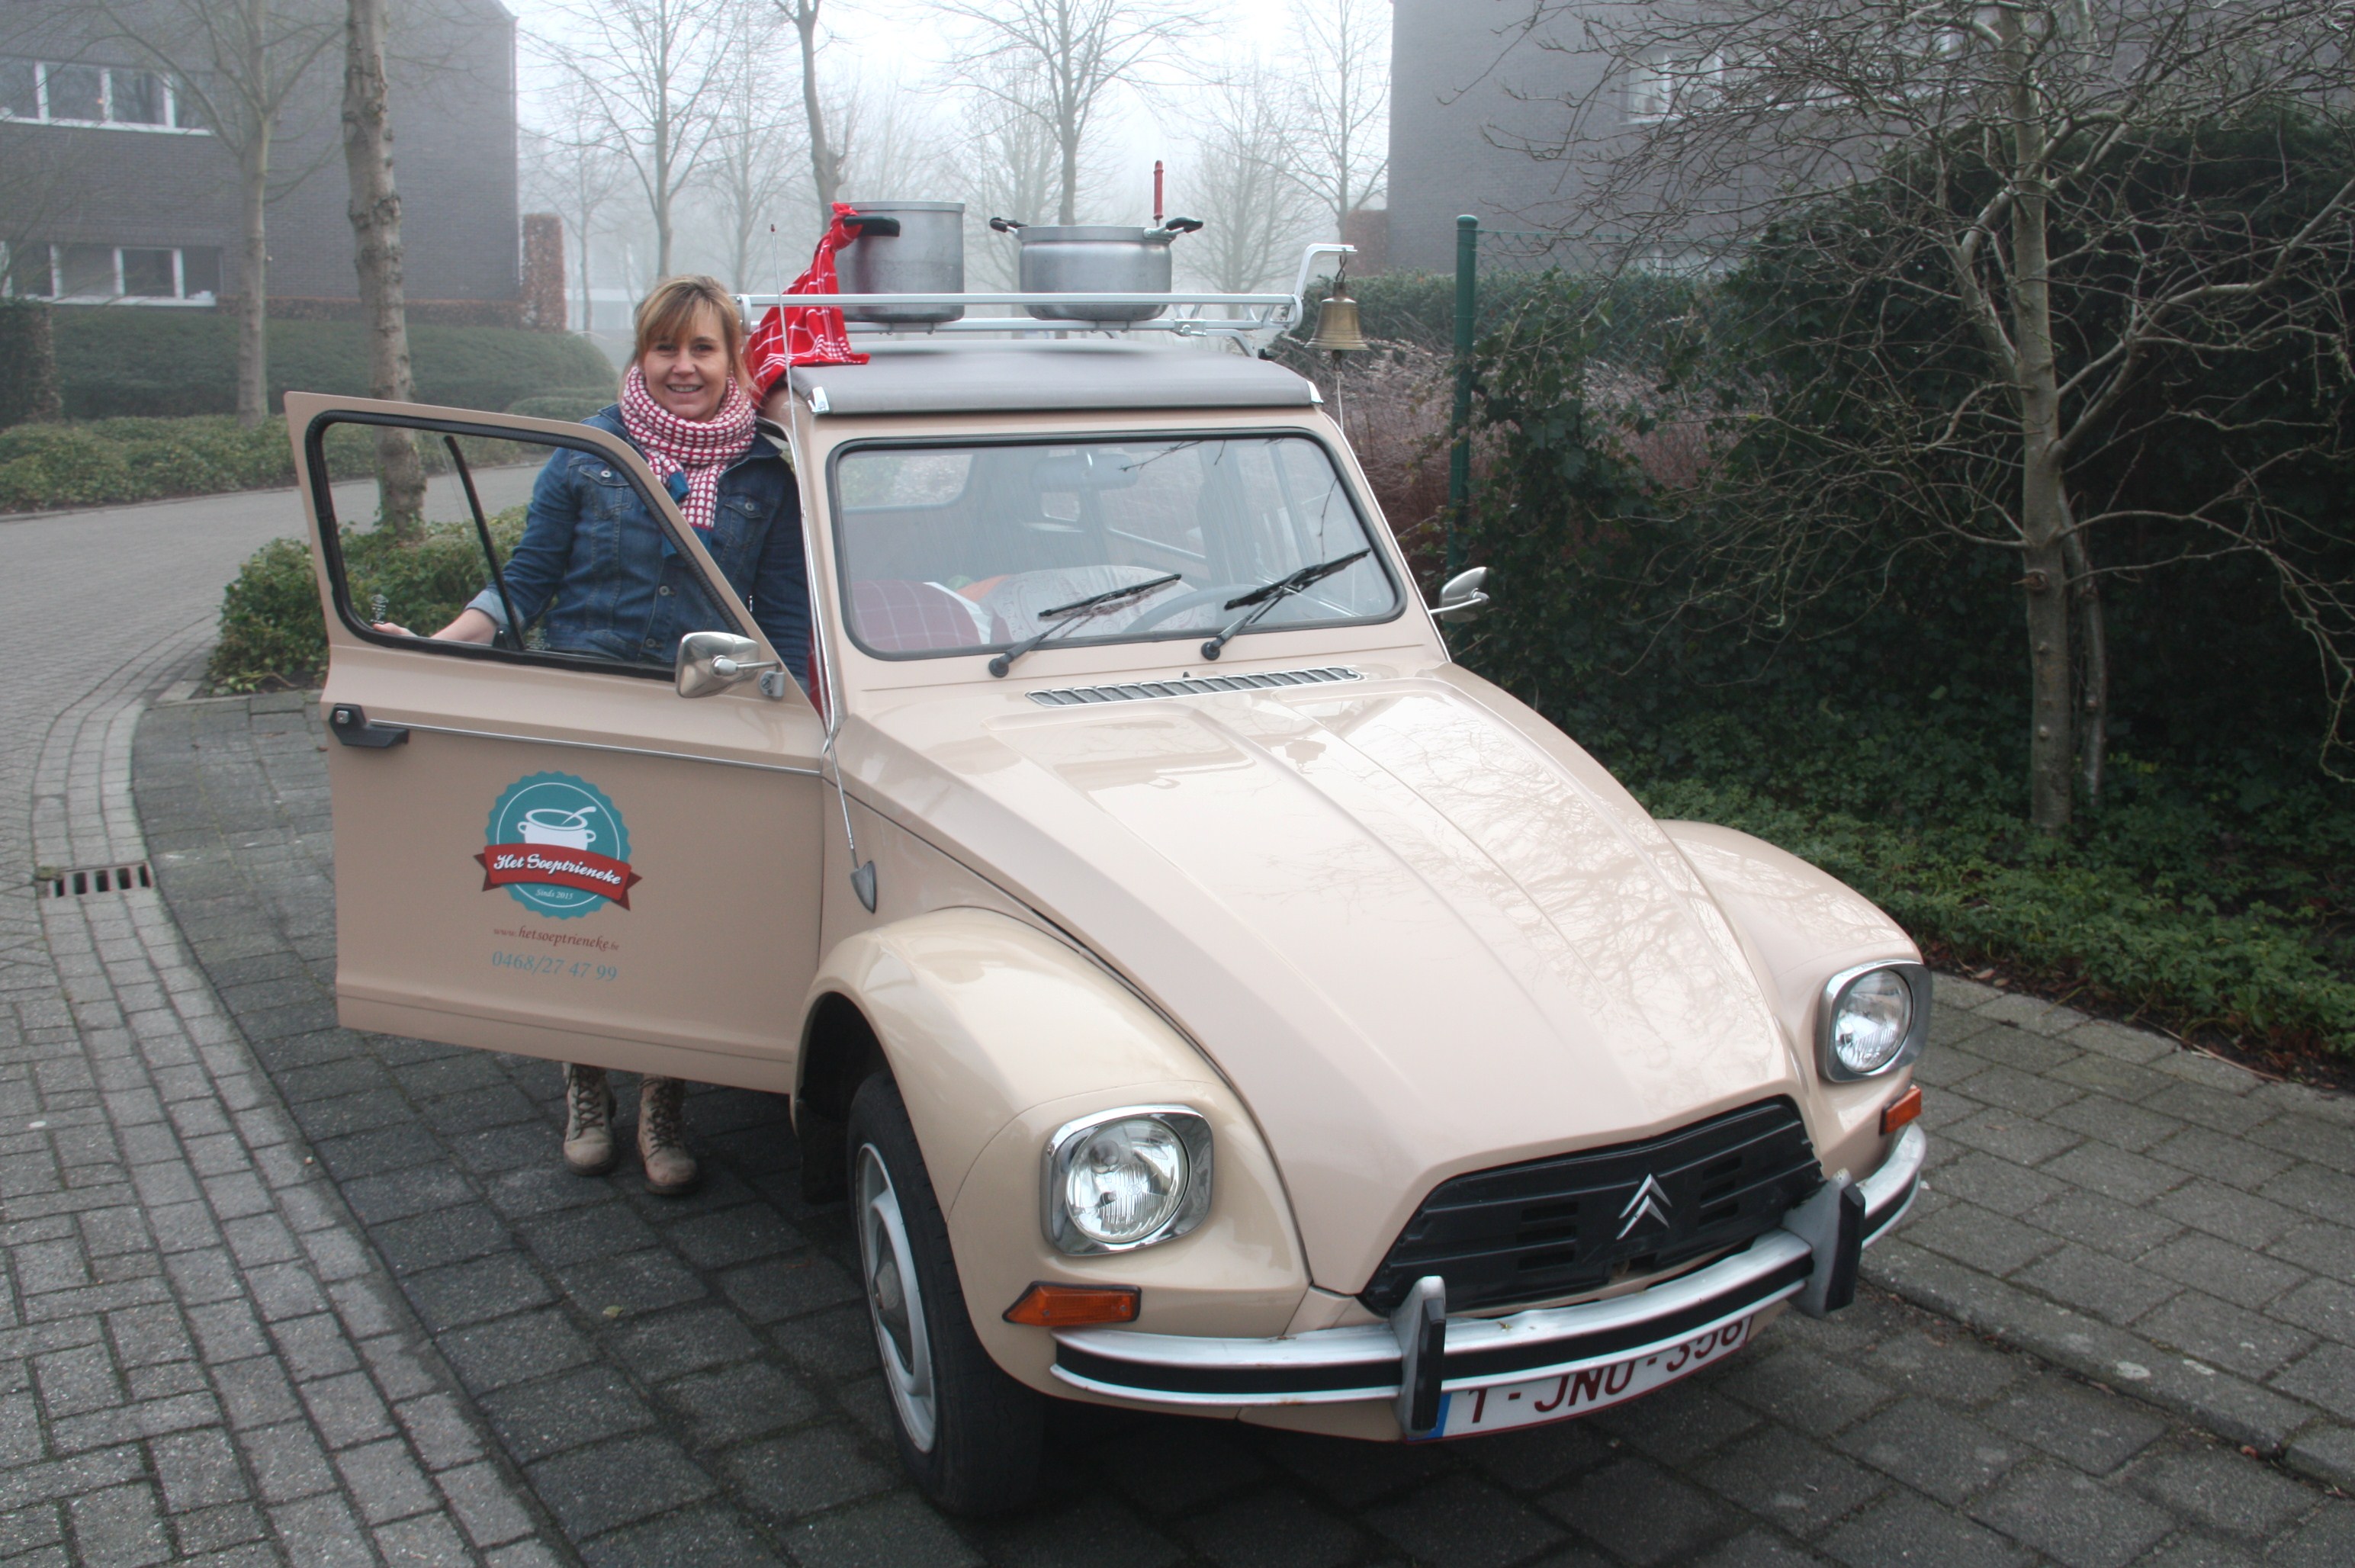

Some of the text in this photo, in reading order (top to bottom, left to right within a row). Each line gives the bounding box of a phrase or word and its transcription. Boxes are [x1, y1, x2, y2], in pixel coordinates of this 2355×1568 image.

[493, 853, 622, 885] Het Soeptrieneke
[535, 888, 573, 900] Sinds 2015
[493, 925, 620, 952] www.hetsoeptrieneke.be
[492, 951, 618, 982] 0468/27 47 99
